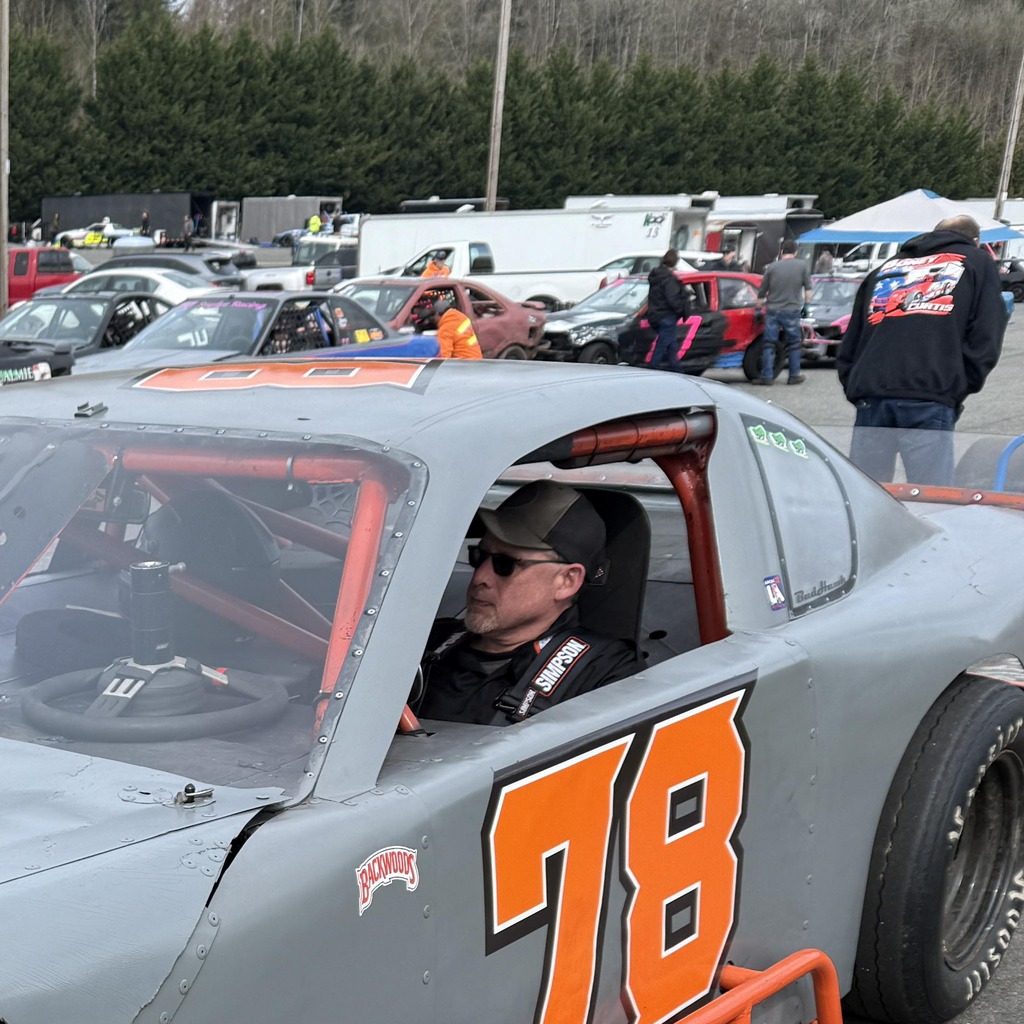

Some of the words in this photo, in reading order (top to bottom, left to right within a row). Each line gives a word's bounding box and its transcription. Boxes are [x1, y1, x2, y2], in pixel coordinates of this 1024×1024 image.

[535, 639, 588, 693] SIMPSON
[518, 689, 537, 716] SIMPSON
[359, 850, 416, 905] BACKWOODS
